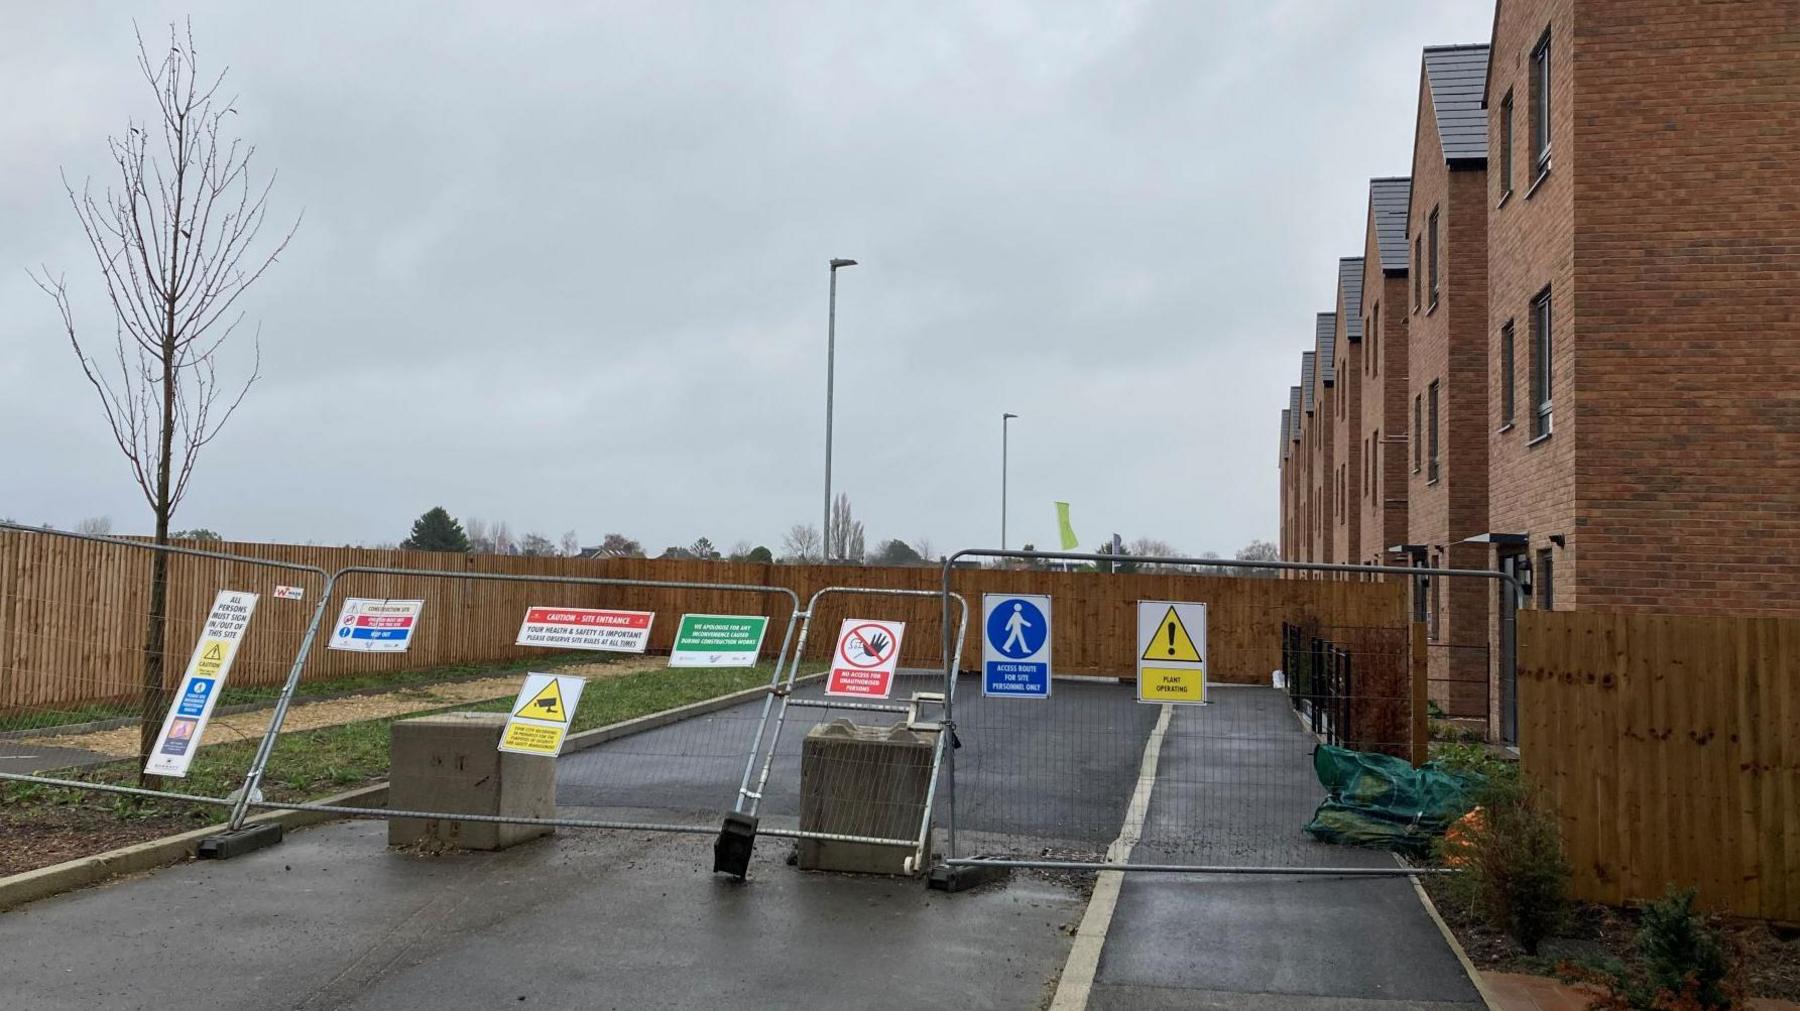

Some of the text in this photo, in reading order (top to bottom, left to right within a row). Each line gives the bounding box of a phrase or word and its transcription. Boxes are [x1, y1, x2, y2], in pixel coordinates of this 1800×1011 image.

[230, 596, 241, 604] ALL
[218, 603, 247, 613] PERSONS
[211, 612, 247, 622] MUST SIGN
[547, 613, 576, 622] CAUTION
[582, 614, 596, 623] SITE
[596, 615, 630, 625] ENTRANCE
[208, 620, 233, 629] IN/OUT
[208, 629, 237, 639] THIS SITE
[545, 626, 568, 634] HEALTH
[575, 628, 597, 636] SAFETY
[605, 630, 642, 639] IMPORTANT
[546, 635, 571, 643] OBSERVE
[620, 640, 637, 648] TIMES
[996, 664, 1037, 673] ACCESS ROUTE
[850, 671, 870, 679] ACCESS
[1004, 673, 1029, 682] FOR SITE
[992, 682, 1041, 691] PERSONNEL ONLY
[1156, 685, 1188, 693] OPERATING
